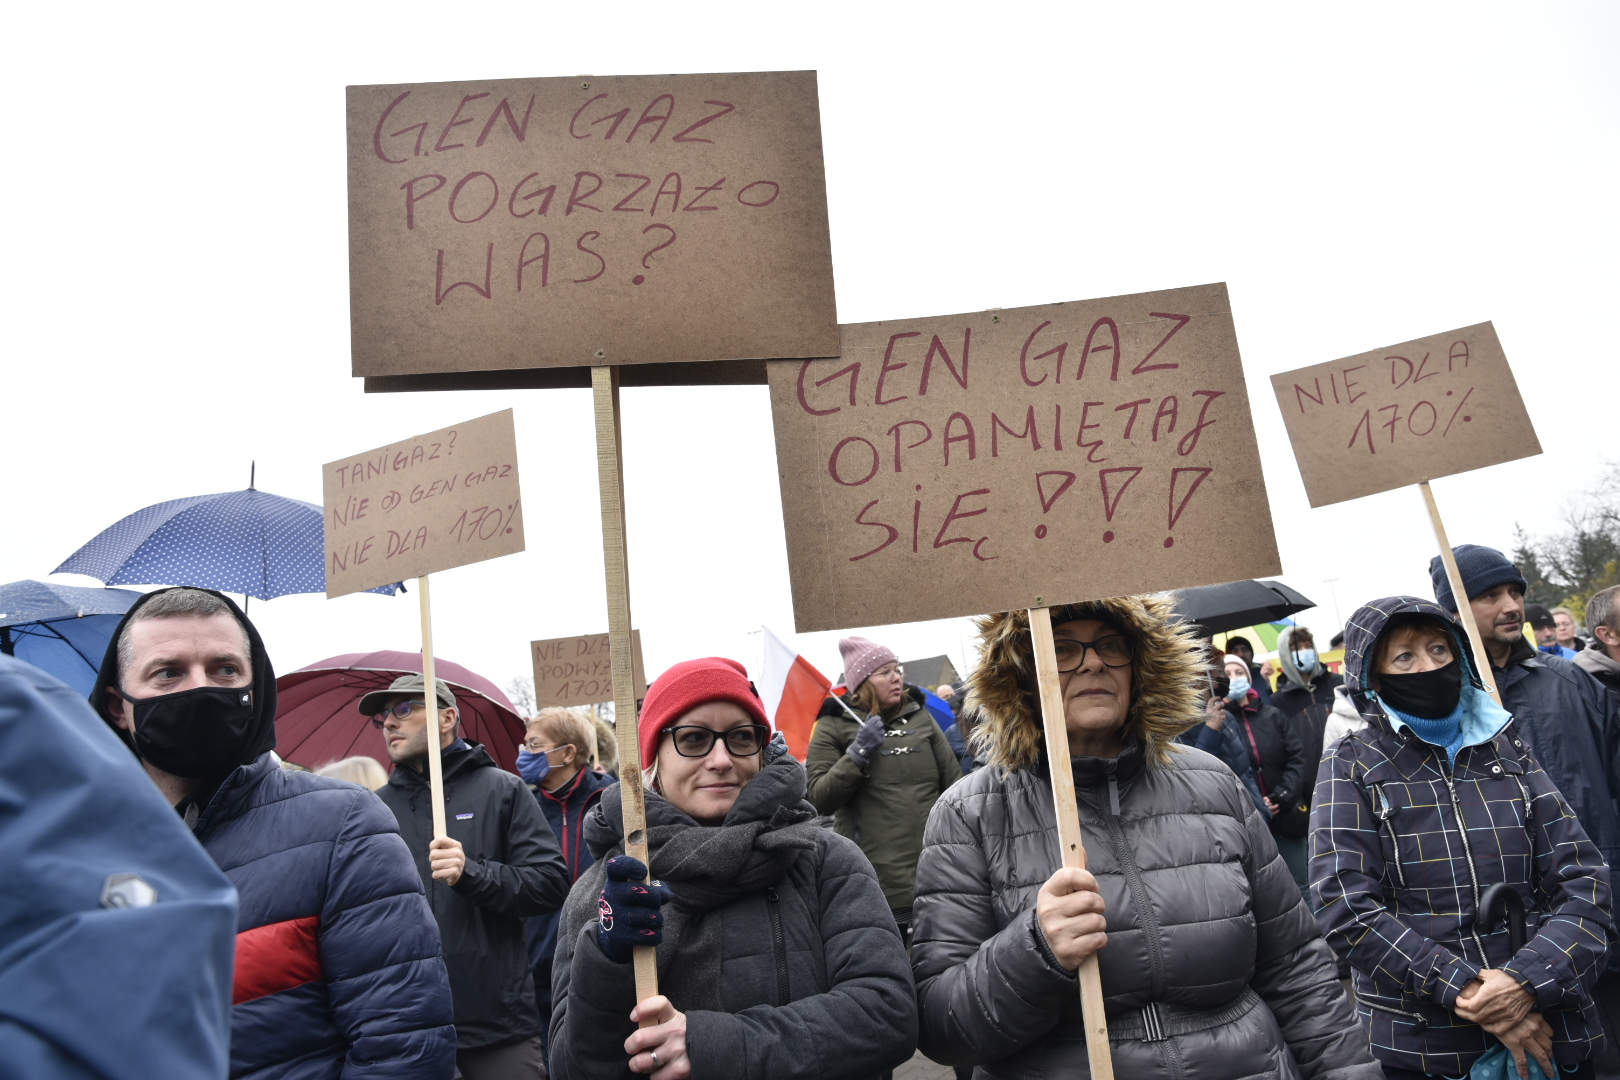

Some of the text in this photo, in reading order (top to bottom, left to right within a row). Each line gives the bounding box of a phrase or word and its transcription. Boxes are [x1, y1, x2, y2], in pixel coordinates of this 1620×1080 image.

[569, 93, 735, 144] GAZ
[435, 223, 677, 306] WAS?
[797, 312, 1190, 416] GEN GAZ
[1294, 340, 1469, 414] NIE DLA
[828, 390, 1226, 486] OPAMIĘTAJ
[1347, 386, 1474, 455] 170%
[409, 474, 457, 504] GEN
[464, 464, 512, 488] GAZ
[332, 499, 519, 576] NIE DLA 170%
[536, 636, 611, 663] NIE DLA
[555, 679, 612, 700] 170%
